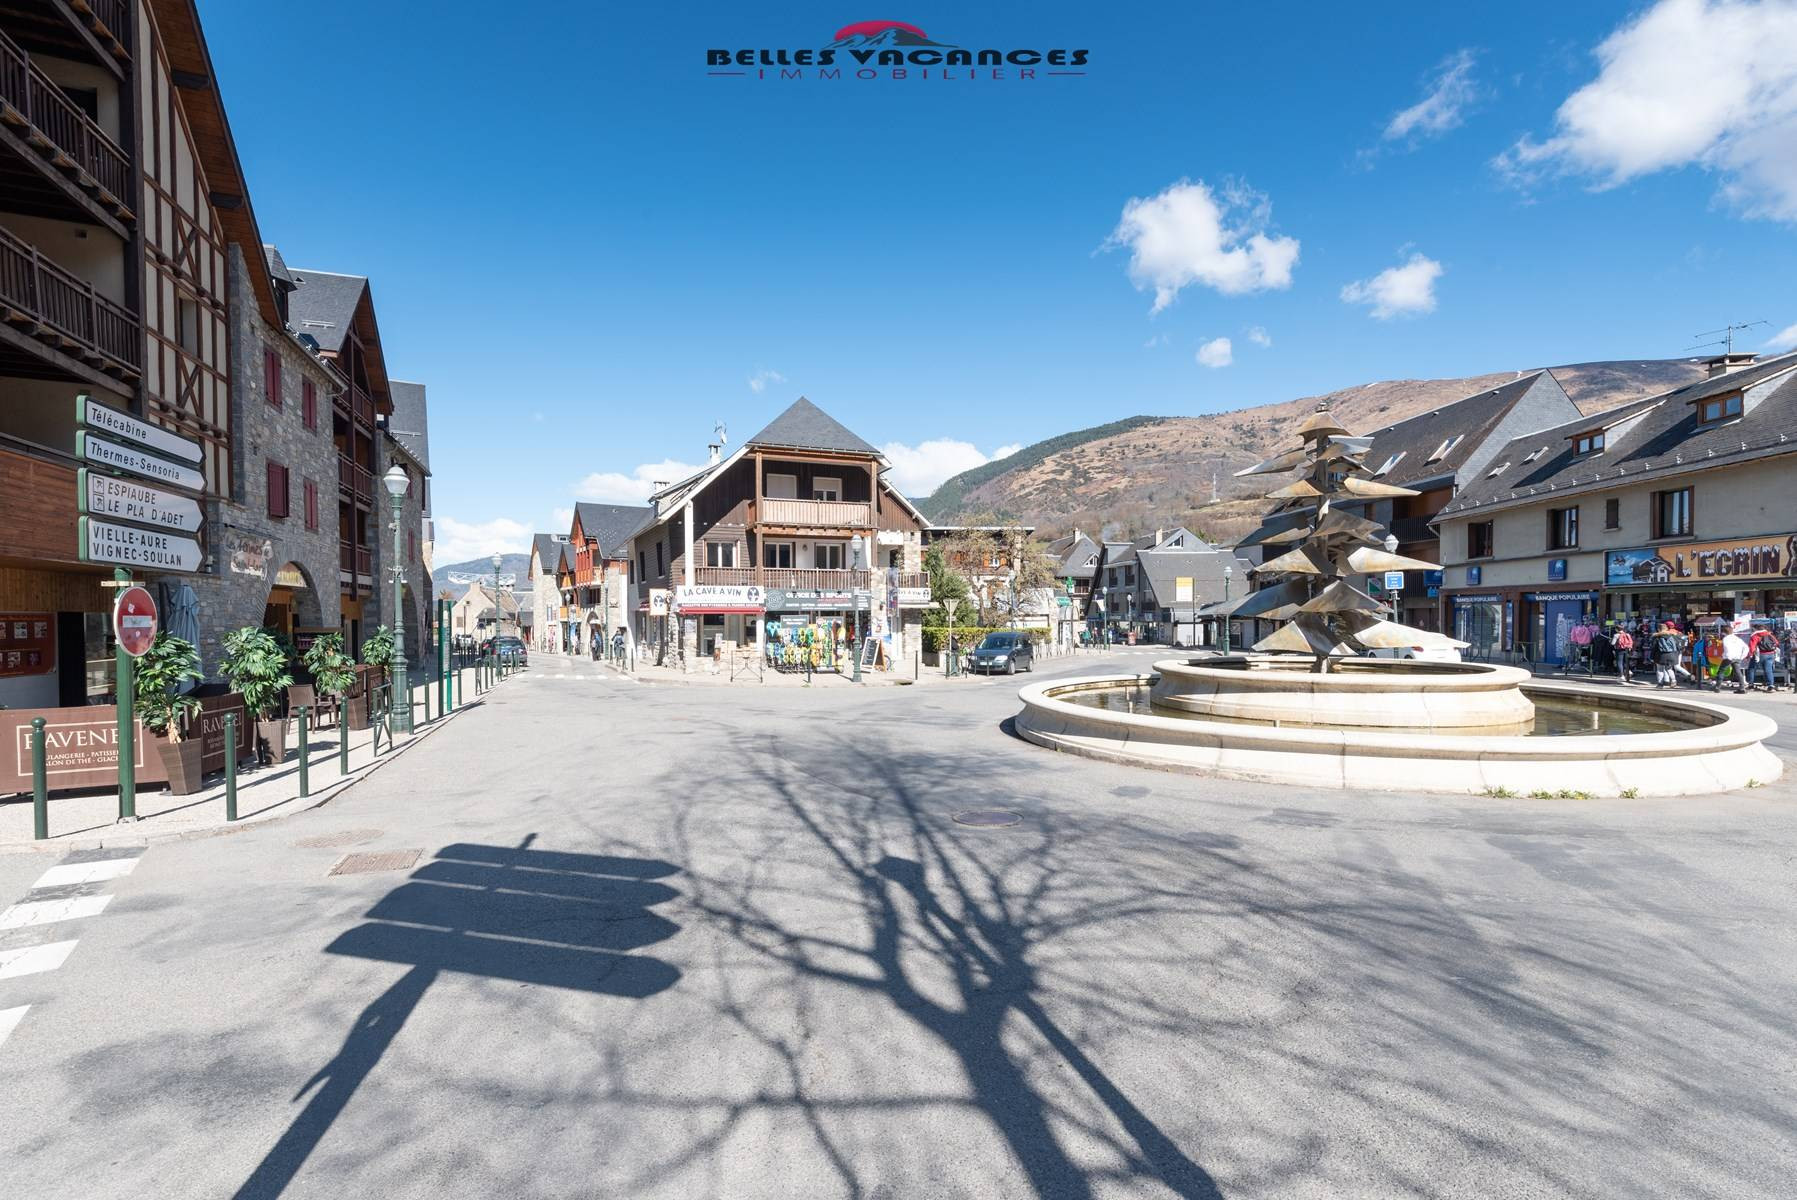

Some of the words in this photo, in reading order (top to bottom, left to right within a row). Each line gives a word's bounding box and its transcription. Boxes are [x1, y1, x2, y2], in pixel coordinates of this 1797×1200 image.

[91, 407, 147, 440] Télécabine
[91, 441, 180, 480] Thermes-Sensoria
[107, 482, 156, 505] ESPIAUBE
[107, 499, 120, 513] LE
[126, 503, 145, 518] PLA
[93, 525, 168, 550] VIELLE-AURE
[93, 542, 182, 567] VIGNEC-SOULAN
[1675, 544, 1781, 578] L'ECRIN
[683, 589, 694, 597] LA
[695, 587, 716, 596] CAVE
[727, 587, 742, 596] VIN
[203, 712, 243, 734] RAVEEL
[24, 728, 137, 750] AVENE
